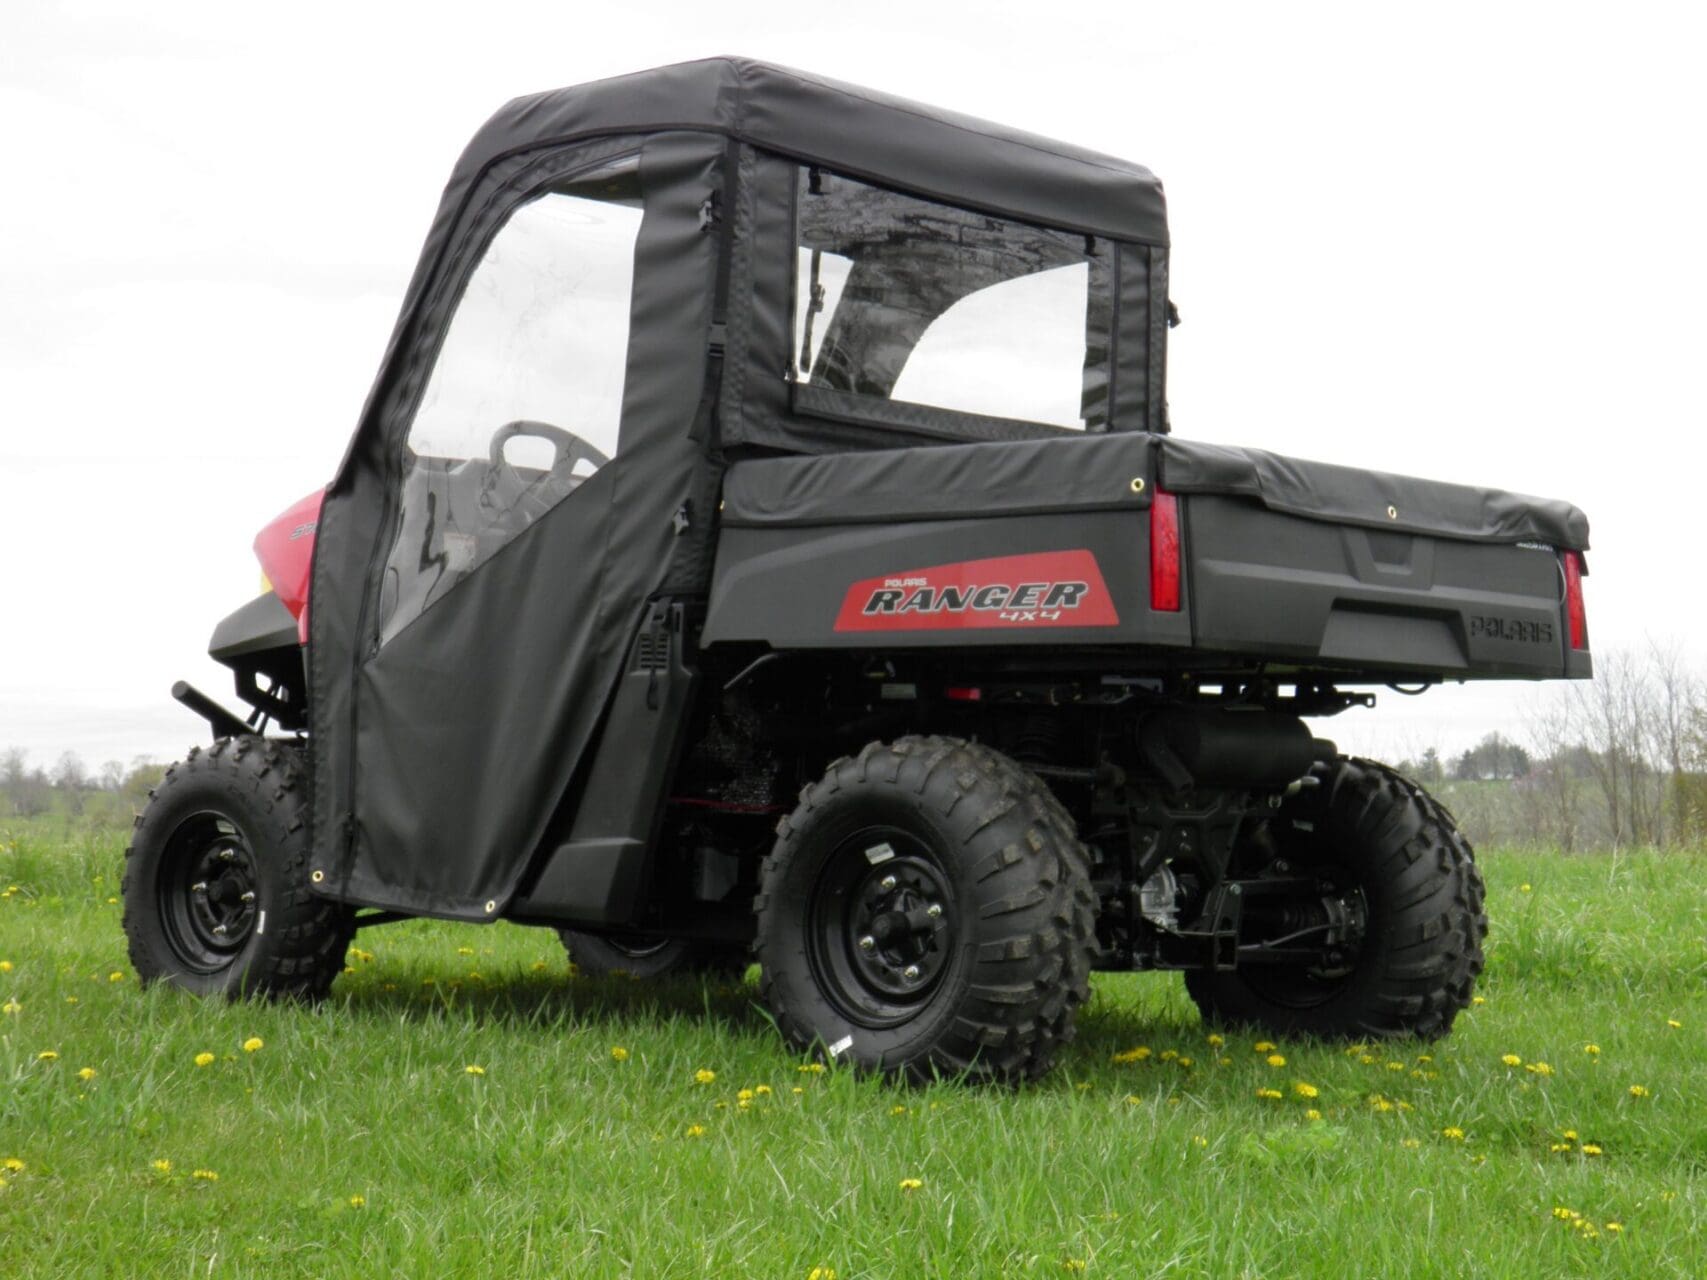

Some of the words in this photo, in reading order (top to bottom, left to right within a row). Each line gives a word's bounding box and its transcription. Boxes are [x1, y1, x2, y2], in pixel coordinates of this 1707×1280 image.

[884, 577, 927, 588] POLARIS
[862, 581, 1089, 615] RANGER
[1470, 615, 1553, 643] POLARIS
